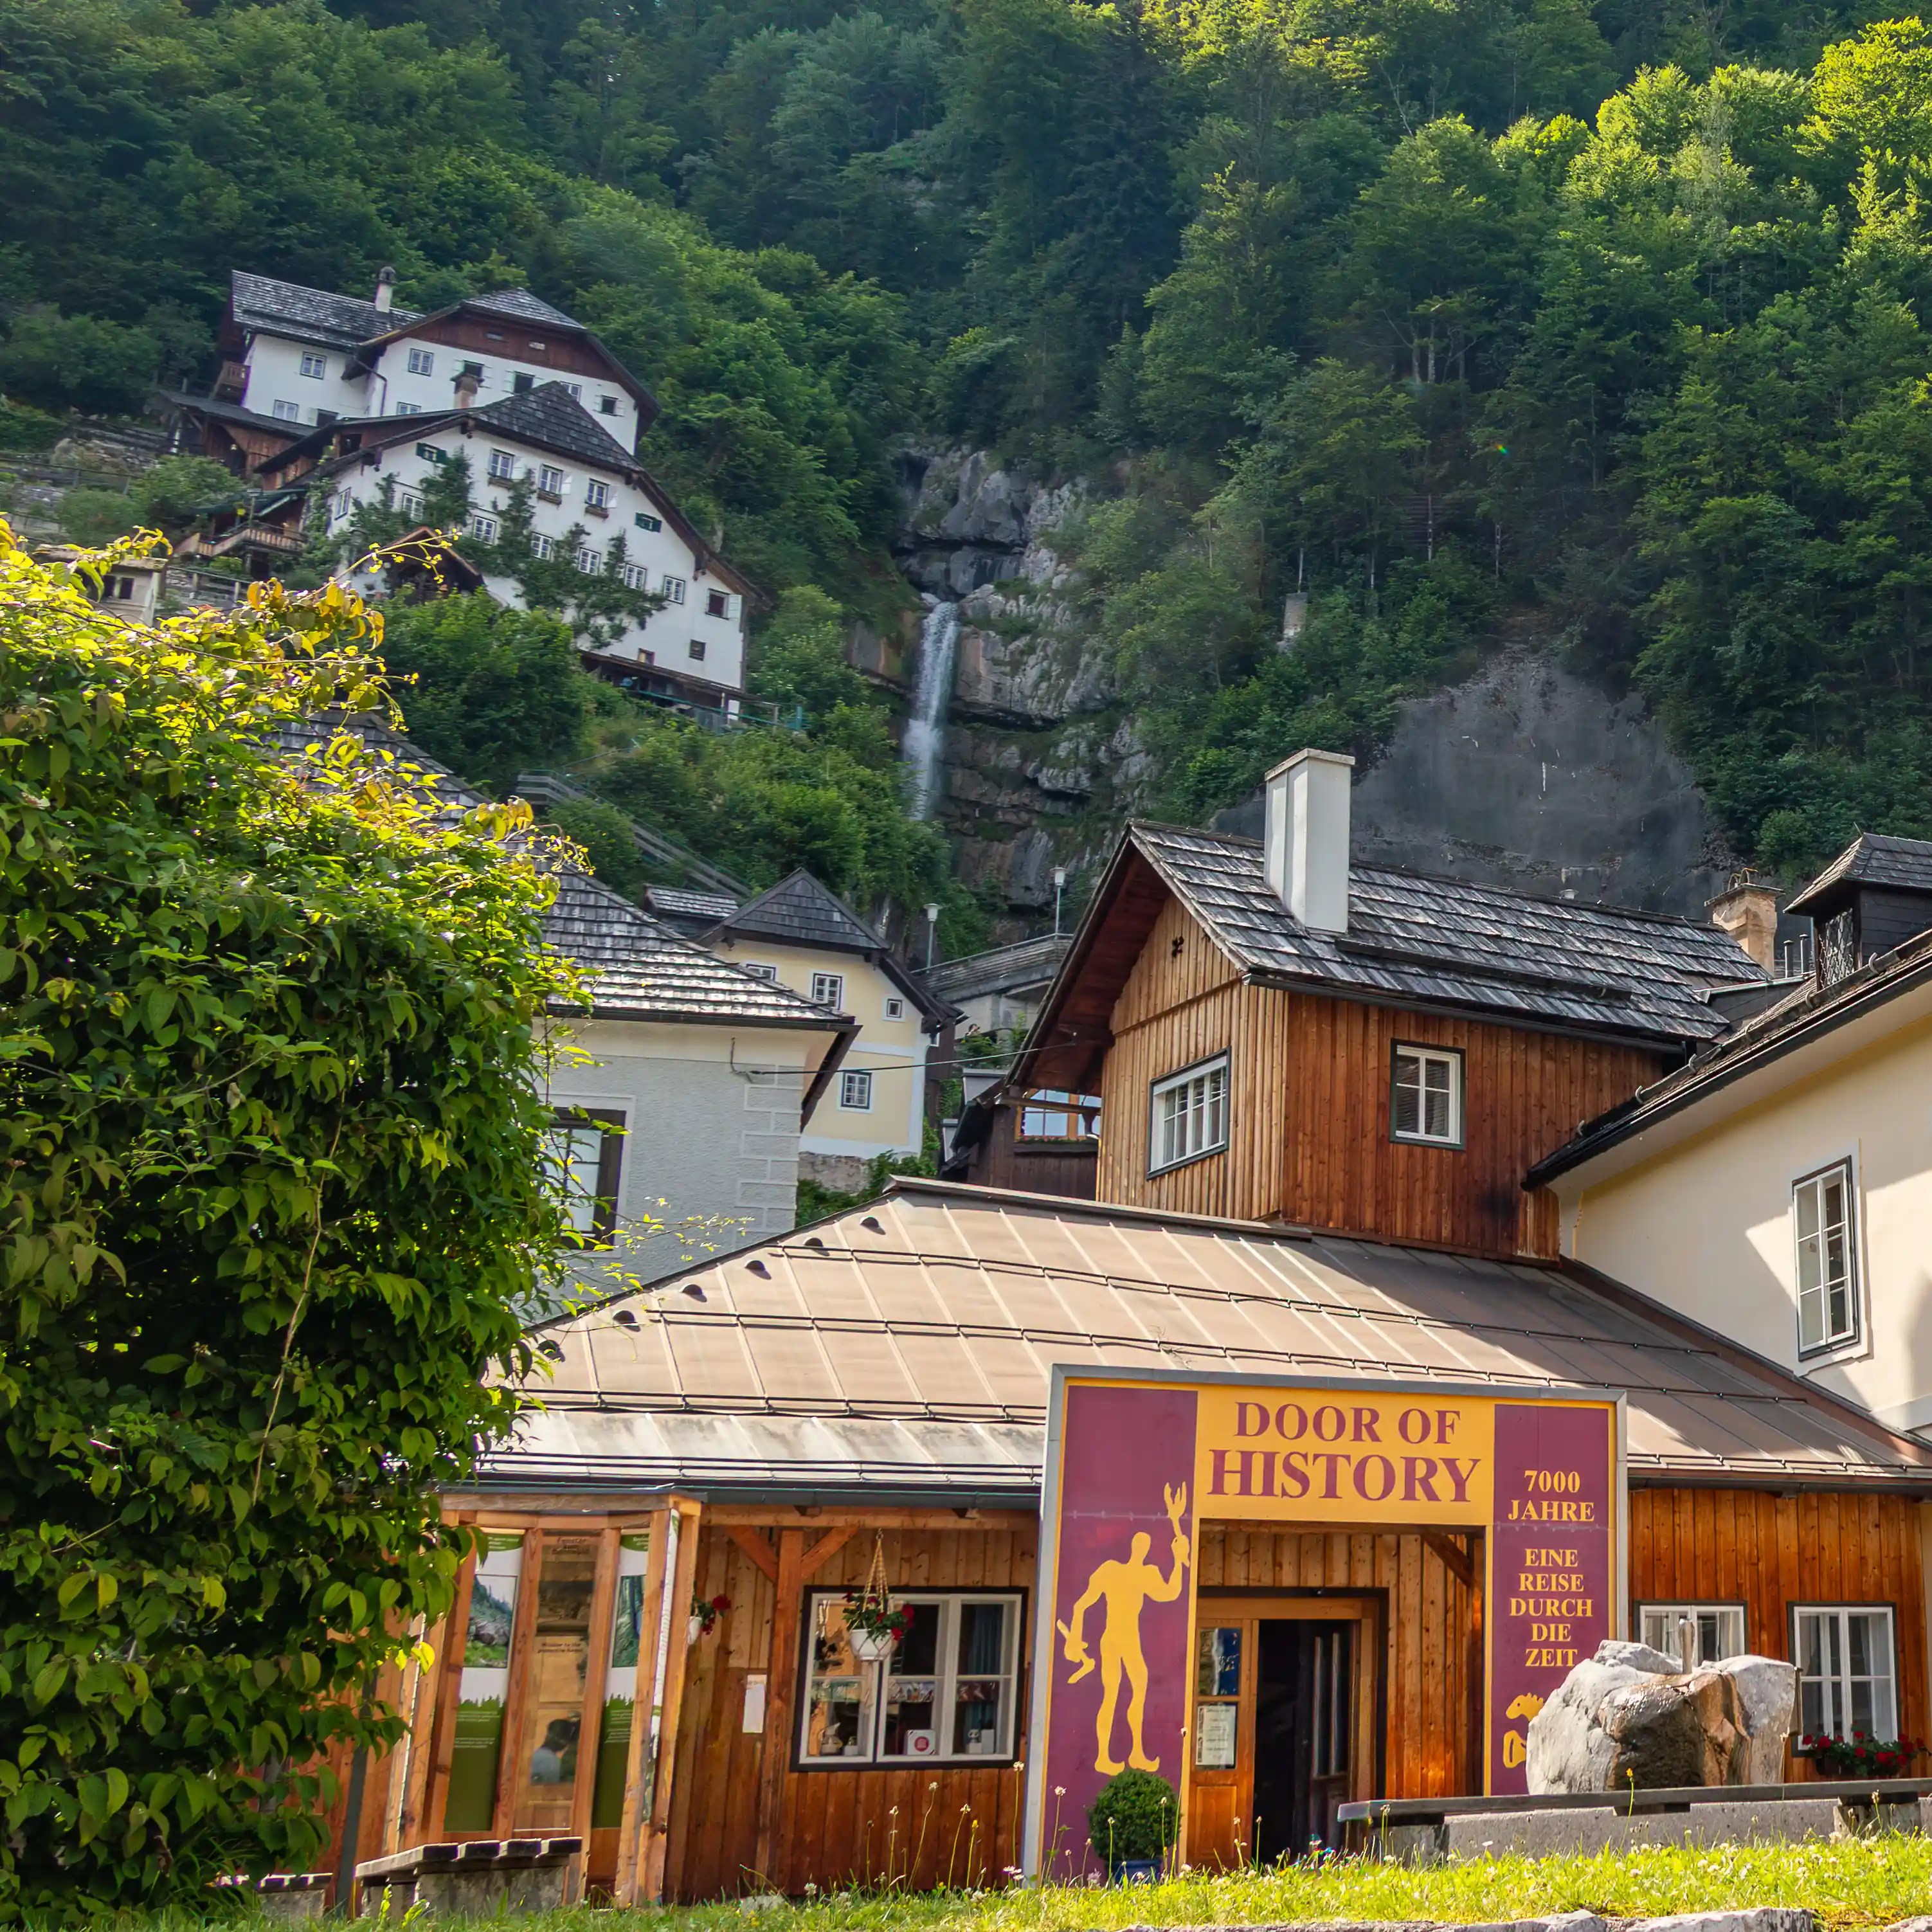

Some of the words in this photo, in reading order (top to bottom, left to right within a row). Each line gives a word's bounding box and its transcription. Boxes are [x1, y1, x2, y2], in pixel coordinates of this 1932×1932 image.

[1233, 1402, 1382, 1442] DOOR
[1398, 1409, 1461, 1444] OF
[1207, 1449, 1481, 1502] HISTORY
[1524, 1470, 1580, 1492] 7000
[1508, 1499, 1594, 1522] JAHRE
[1524, 1548, 1578, 1567] EINE
[1519, 1573, 1584, 1592] REISE
[1510, 1598, 1593, 1616] DURCH
[1531, 1623, 1571, 1641] DIE
[1525, 1648, 1578, 1666] ZEIT
